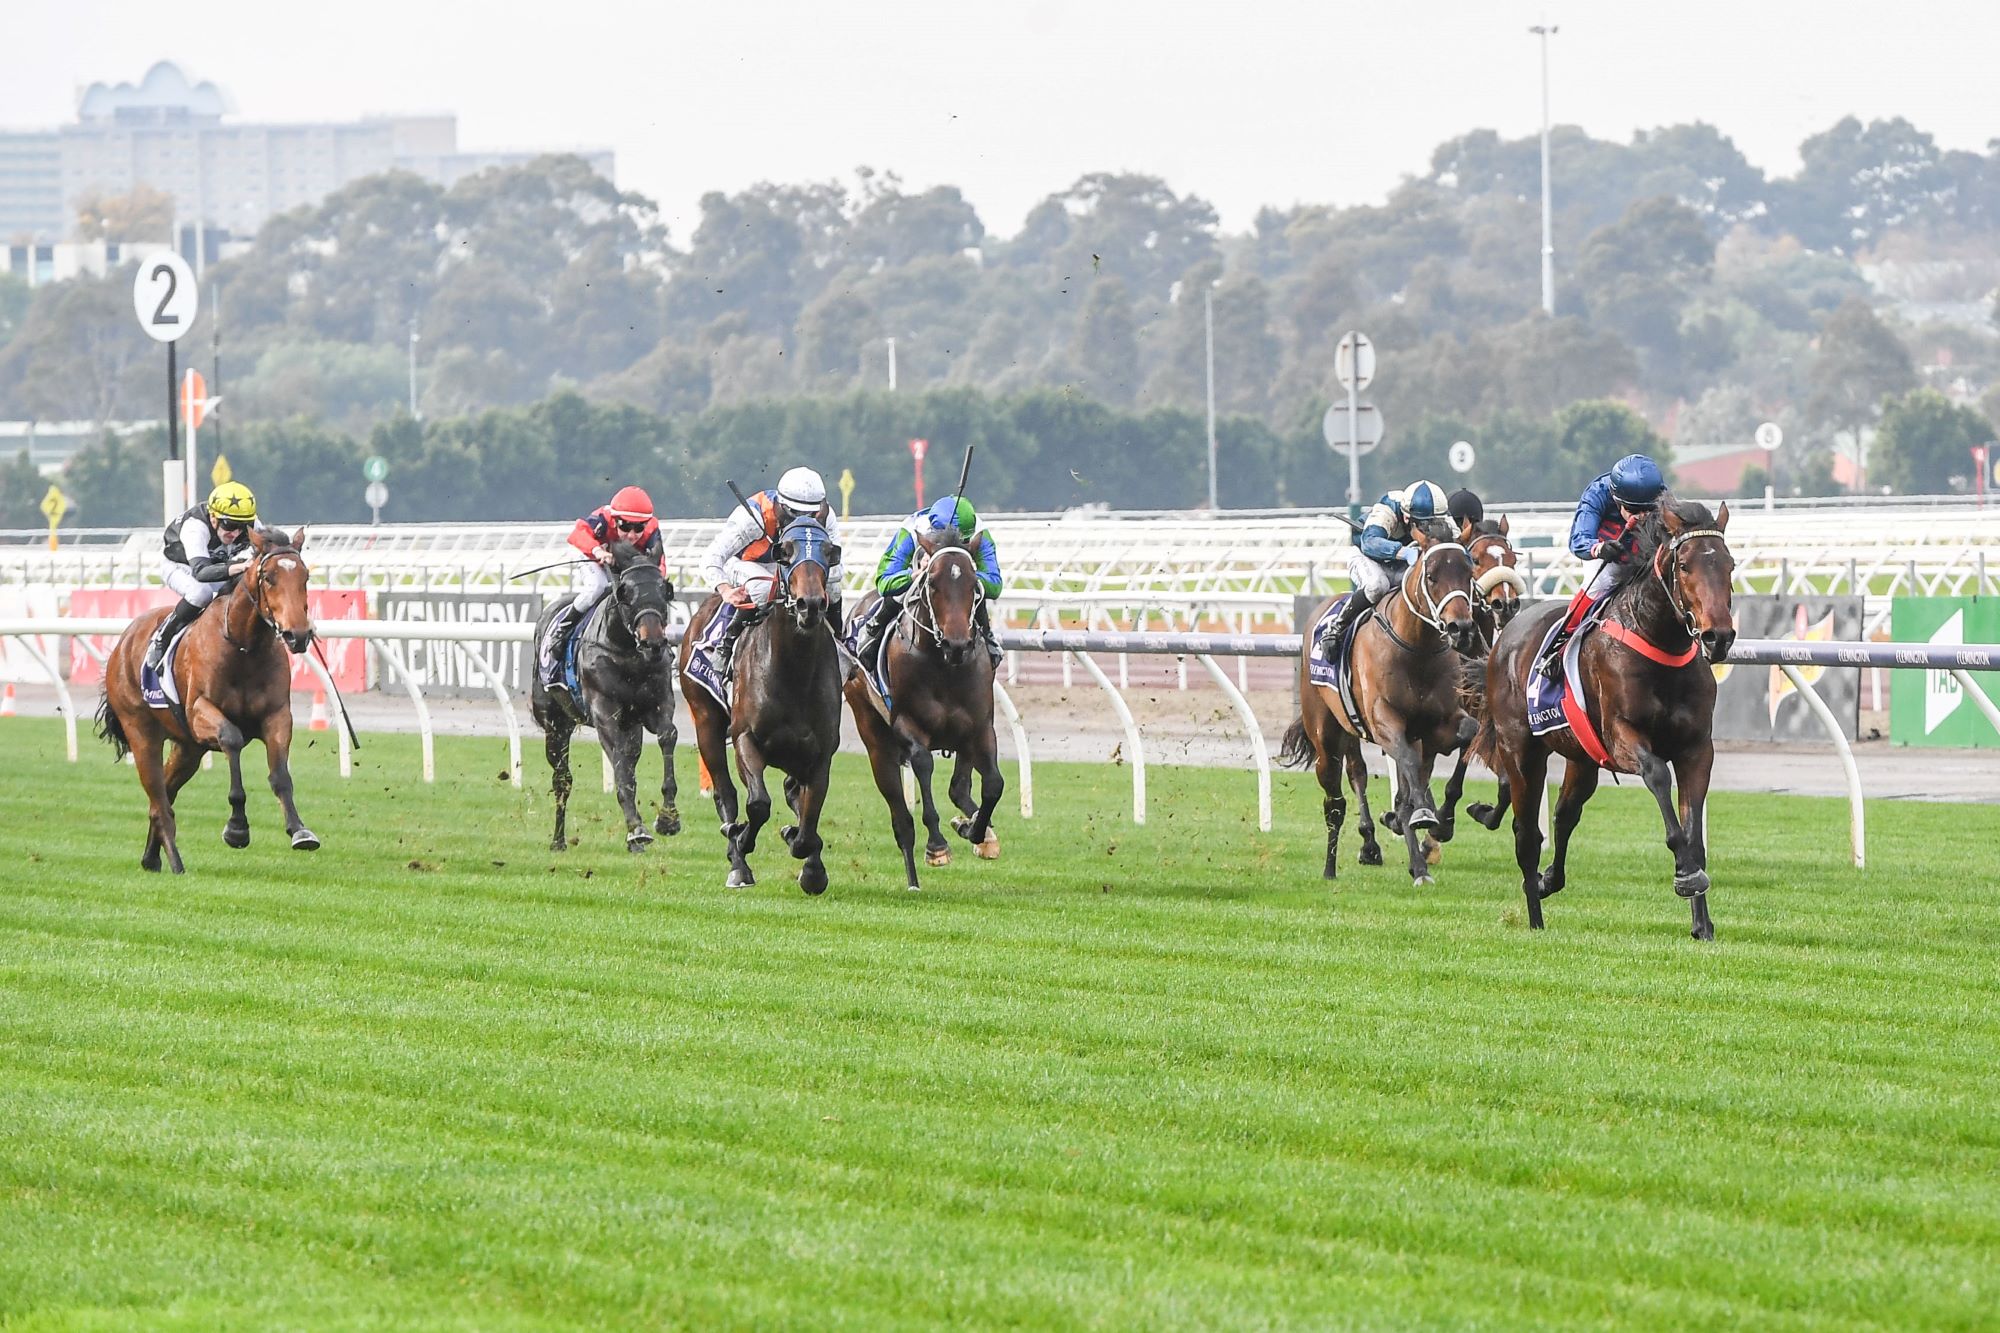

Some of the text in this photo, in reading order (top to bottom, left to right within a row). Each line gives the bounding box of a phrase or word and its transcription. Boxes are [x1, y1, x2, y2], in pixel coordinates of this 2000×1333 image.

[151, 264, 179, 325] 2
[49, 498, 60, 515] 2
[386, 600, 531, 690] KENNEDY
